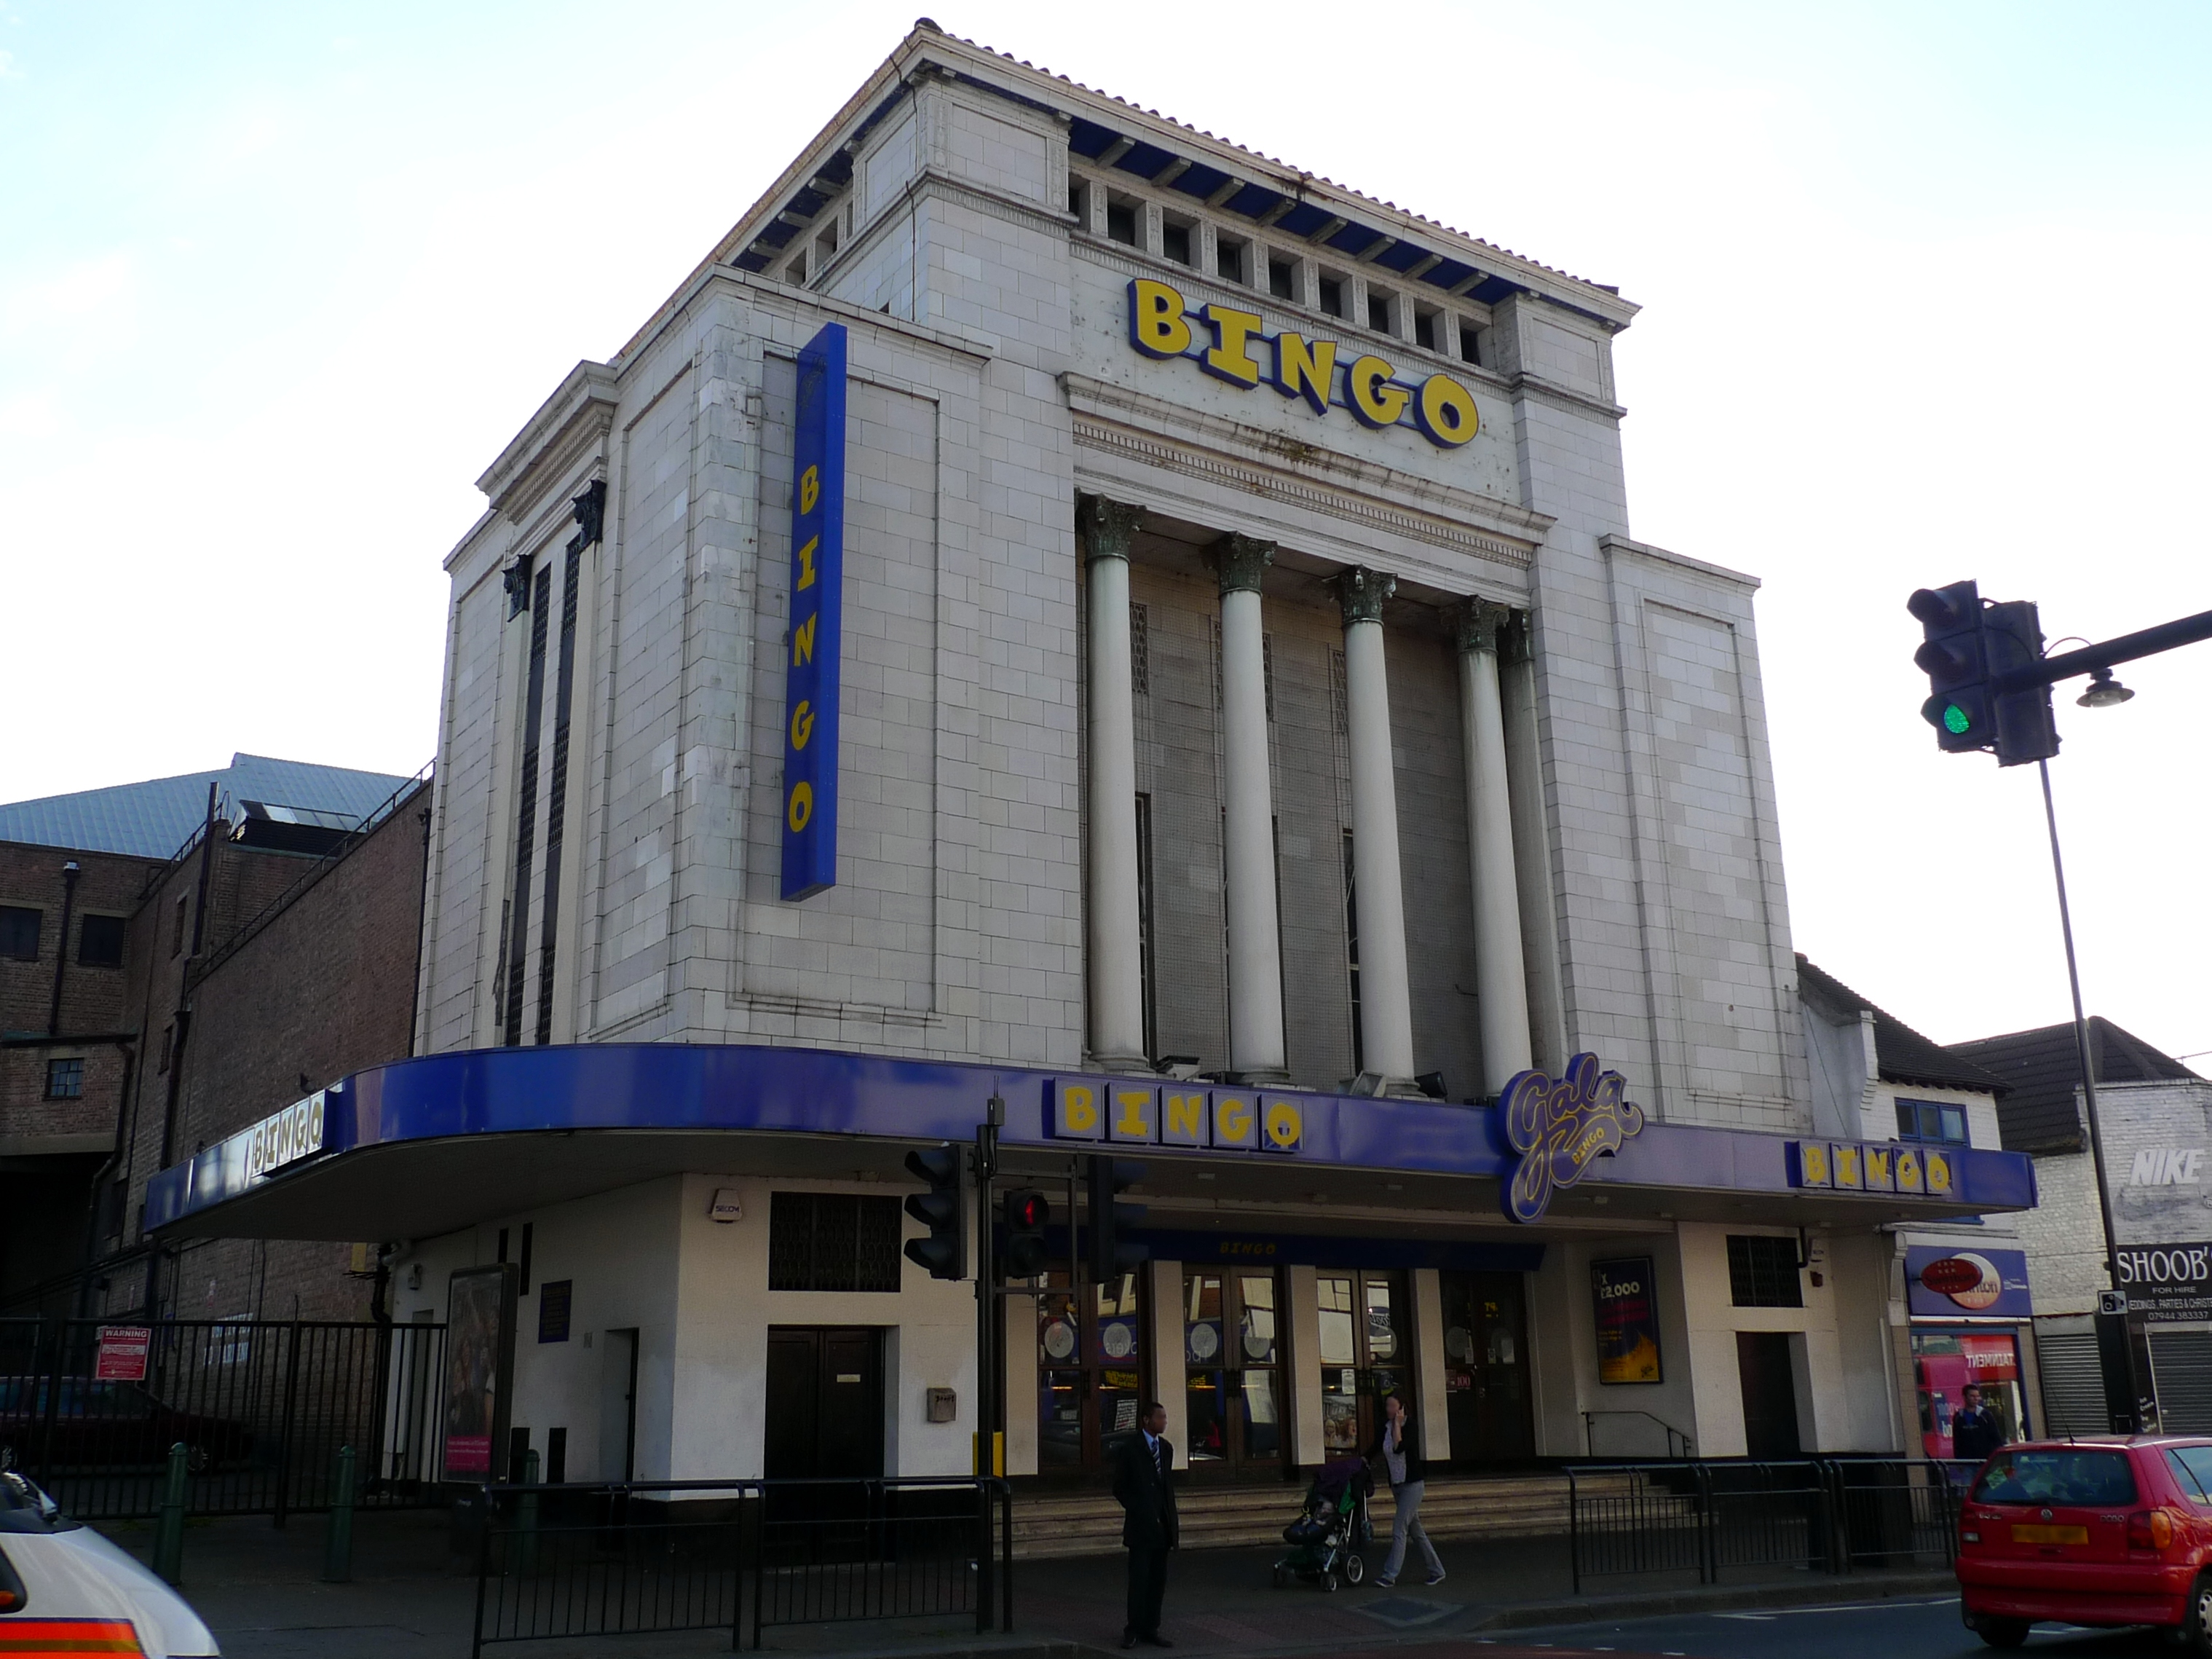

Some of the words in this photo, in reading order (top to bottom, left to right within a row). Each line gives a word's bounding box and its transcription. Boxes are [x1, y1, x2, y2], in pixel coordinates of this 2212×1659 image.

[1127, 277, 1480, 449] BINGO
[789, 464, 819, 833] BINGO
[254, 1101, 323, 1170] BINGO
[1064, 1086, 1302, 1146] BINGO
[1506, 1054, 1644, 1222] Gala
[1571, 1127, 1605, 1165] BINGO
[1804, 1146, 1950, 1190] BINGO
[2130, 1148, 2205, 1186] NIKE
[1220, 1241, 1277, 1255] BINGO
[2117, 1246, 2212, 1282] SHOOB'
[106, 1329, 147, 1337] WARNING
[2148, 1312, 2175, 1320] 07944
